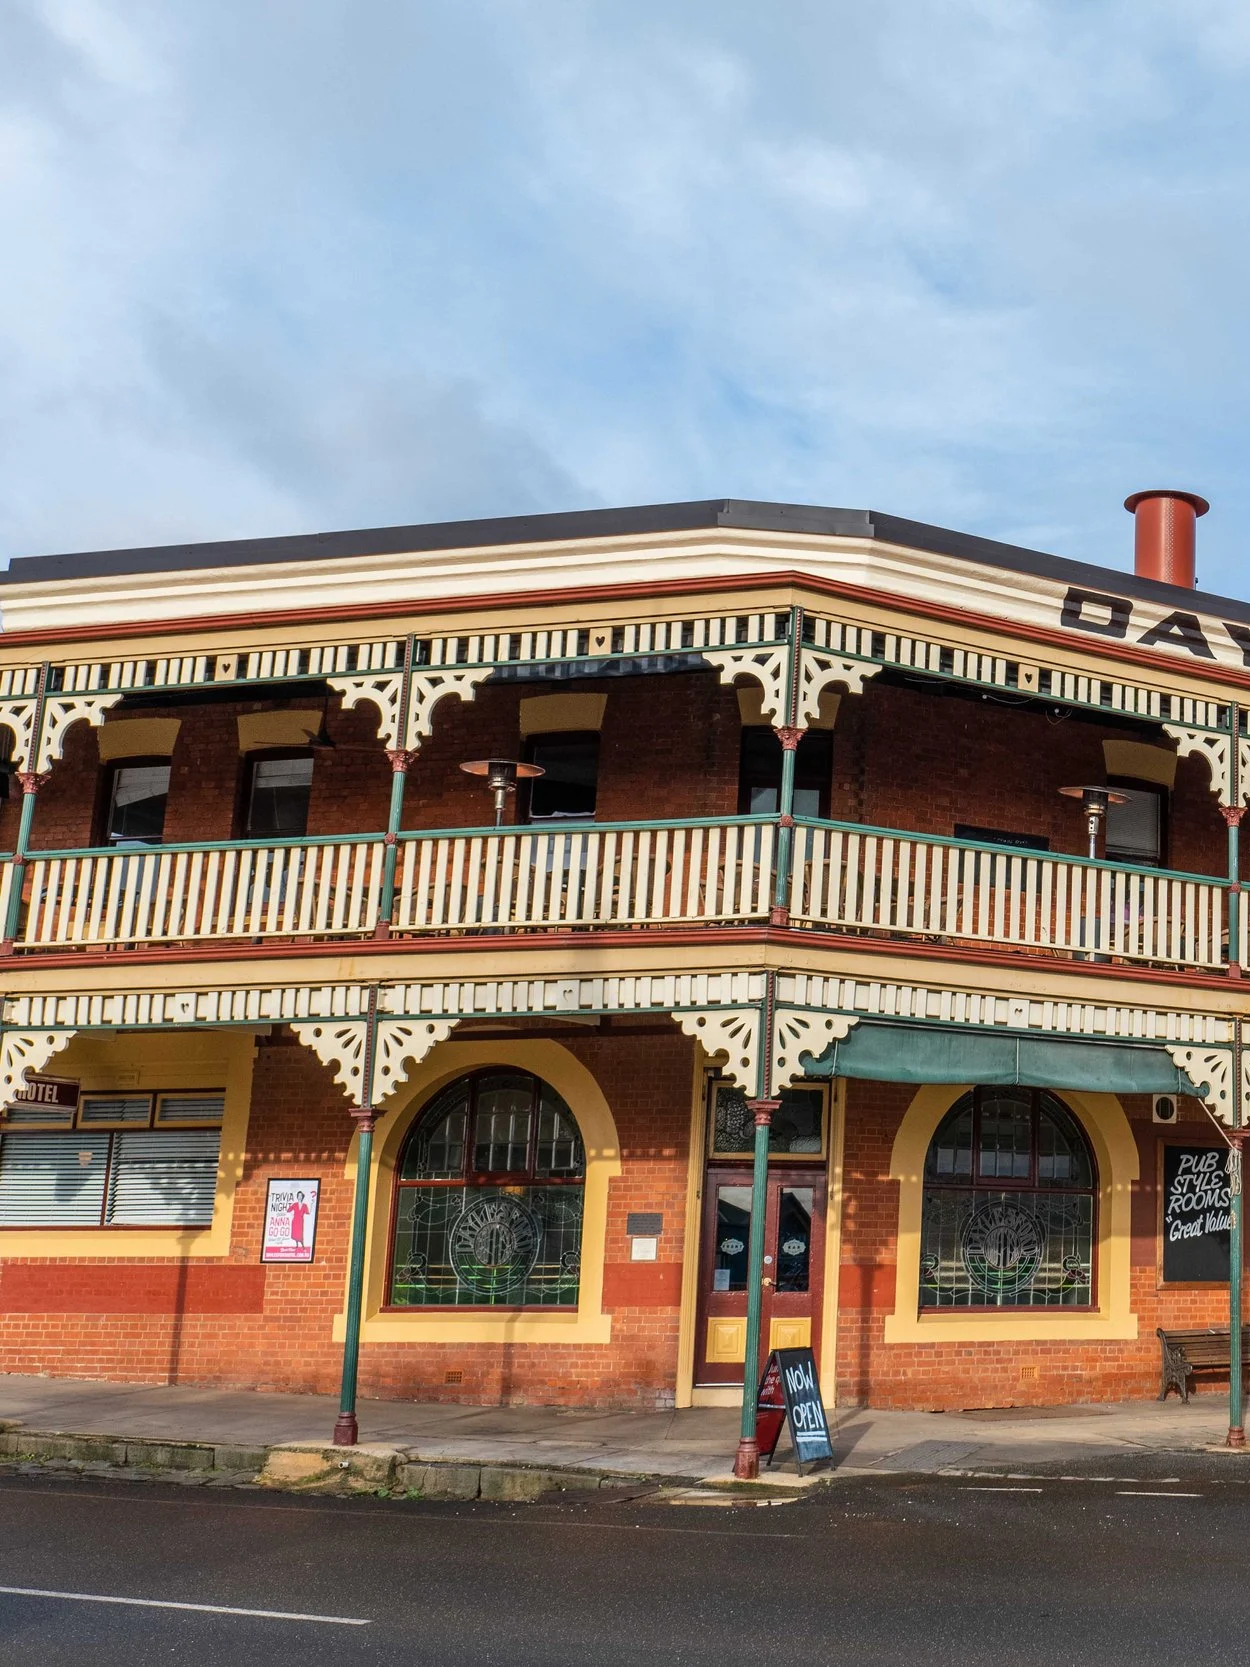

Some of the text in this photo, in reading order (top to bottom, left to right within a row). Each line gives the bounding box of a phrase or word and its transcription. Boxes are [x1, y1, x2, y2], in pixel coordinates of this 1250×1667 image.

[1178, 1152, 1220, 1175] PUB
[1170, 1170, 1224, 1194] STYLE
[271, 1192, 294, 1202] TRIVIA
[1167, 1187, 1230, 1214] ROOMS
[268, 1226, 290, 1237] GO GO
[269, 1217, 290, 1227] ANNA
[785, 1361, 814, 1394] NOW
[792, 1400, 825, 1430] OPEN
